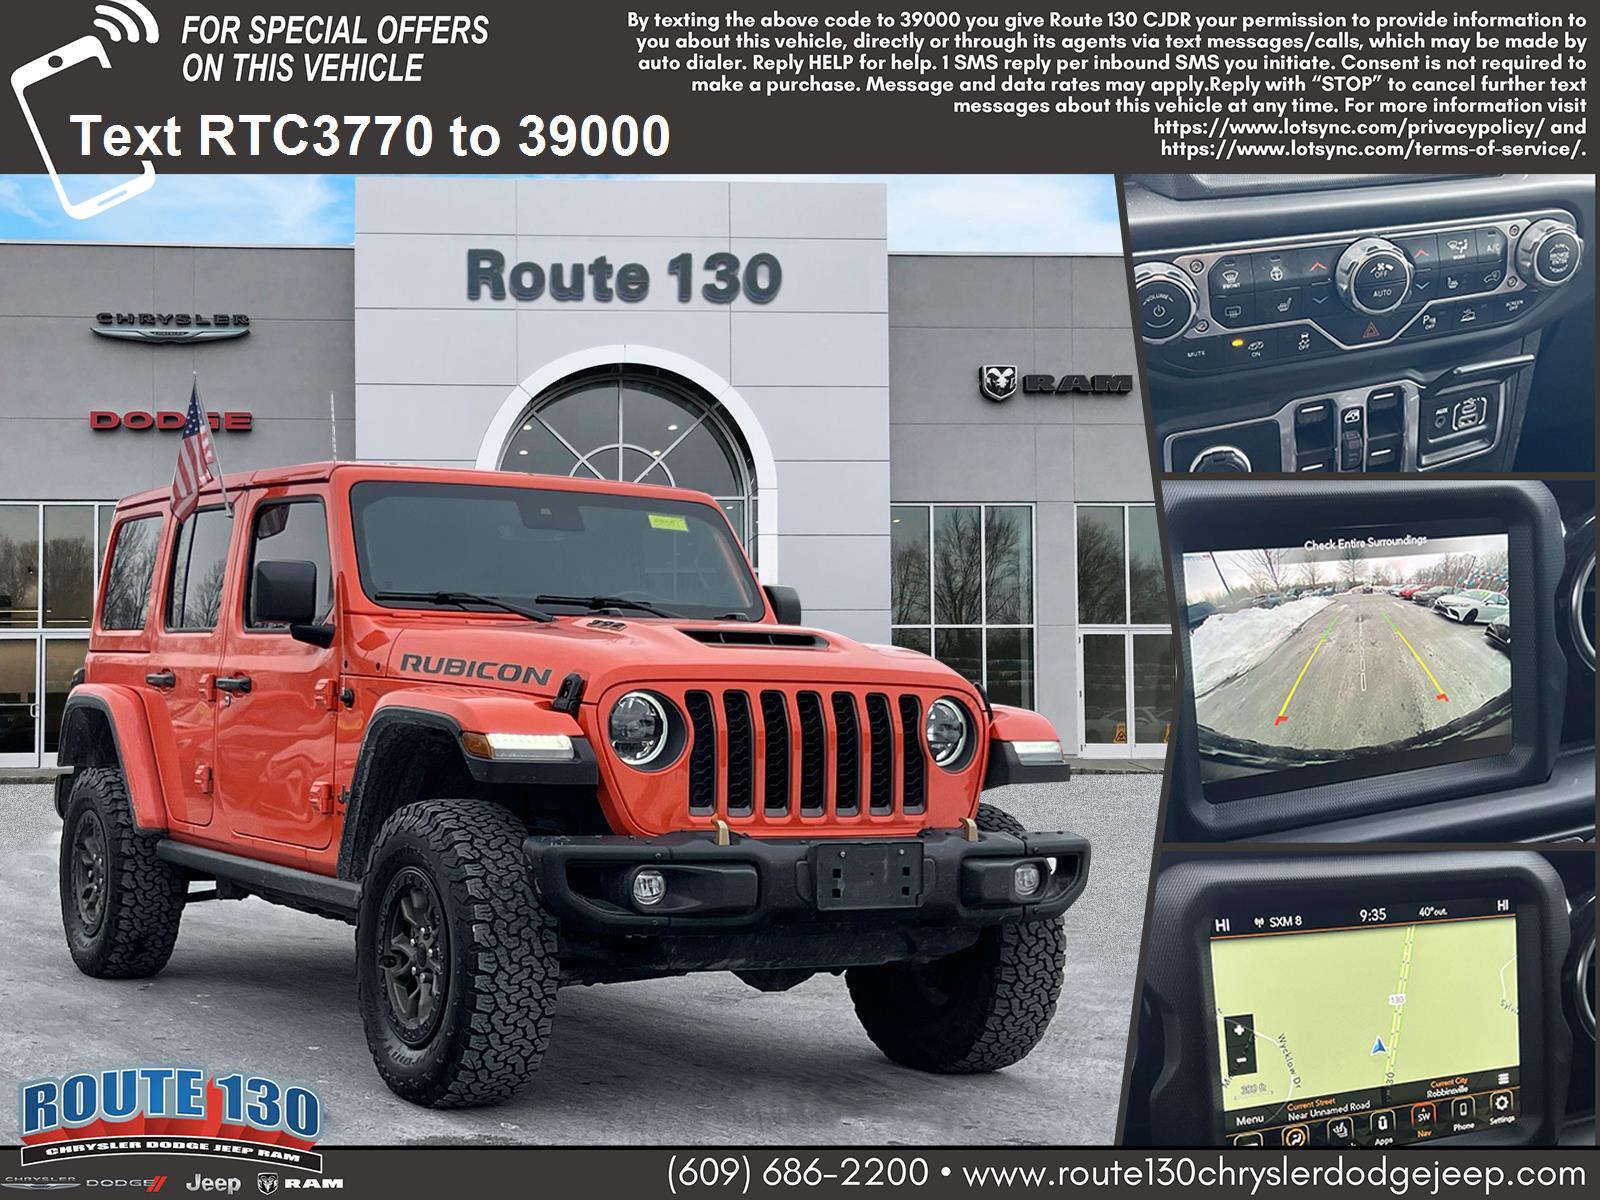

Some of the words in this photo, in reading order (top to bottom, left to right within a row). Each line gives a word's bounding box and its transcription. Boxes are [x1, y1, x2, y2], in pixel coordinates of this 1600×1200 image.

[466, 249, 650, 302] Route
[668, 252, 782, 304] 130
[1374, 269, 1388, 279] OFF
[1372, 288, 1392, 298] AUTO
[96, 312, 250, 326] CHRYSLER
[1187, 350, 1206, 358] MUTE
[1022, 374, 1133, 394] RAM
[1304, 539, 1336, 551] Check
[1338, 537, 1366, 549] Entire
[1367, 534, 1427, 547] Surroundings
[400, 653, 553, 686] RUBICON
[1497, 899, 1510, 911] HI
[1269, 916, 1293, 928] SXM
[1295, 915, 1303, 927] 8
[1359, 908, 1387, 922] 9:35
[1215, 918, 1230, 932] HI
[1293, 1076, 1302, 1089] Dr
[1430, 1078, 1454, 1088] Current
[1455, 1076, 1469, 1085] City
[1426, 1085, 1469, 1098] Robbinsville
[1287, 1101, 1315, 1111] Current
[1315, 1098, 1336, 1108] Street
[1287, 1111, 1308, 1121] Near
[1309, 1104, 1349, 1118] Unnamed
[1350, 1100, 1370, 1111] Road
[1236, 1116, 1264, 1126] Menu
[1453, 1122, 1475, 1132] Phone
[1489, 1115, 1515, 1126] Settings
[1417, 1129, 1432, 1138] Nav
